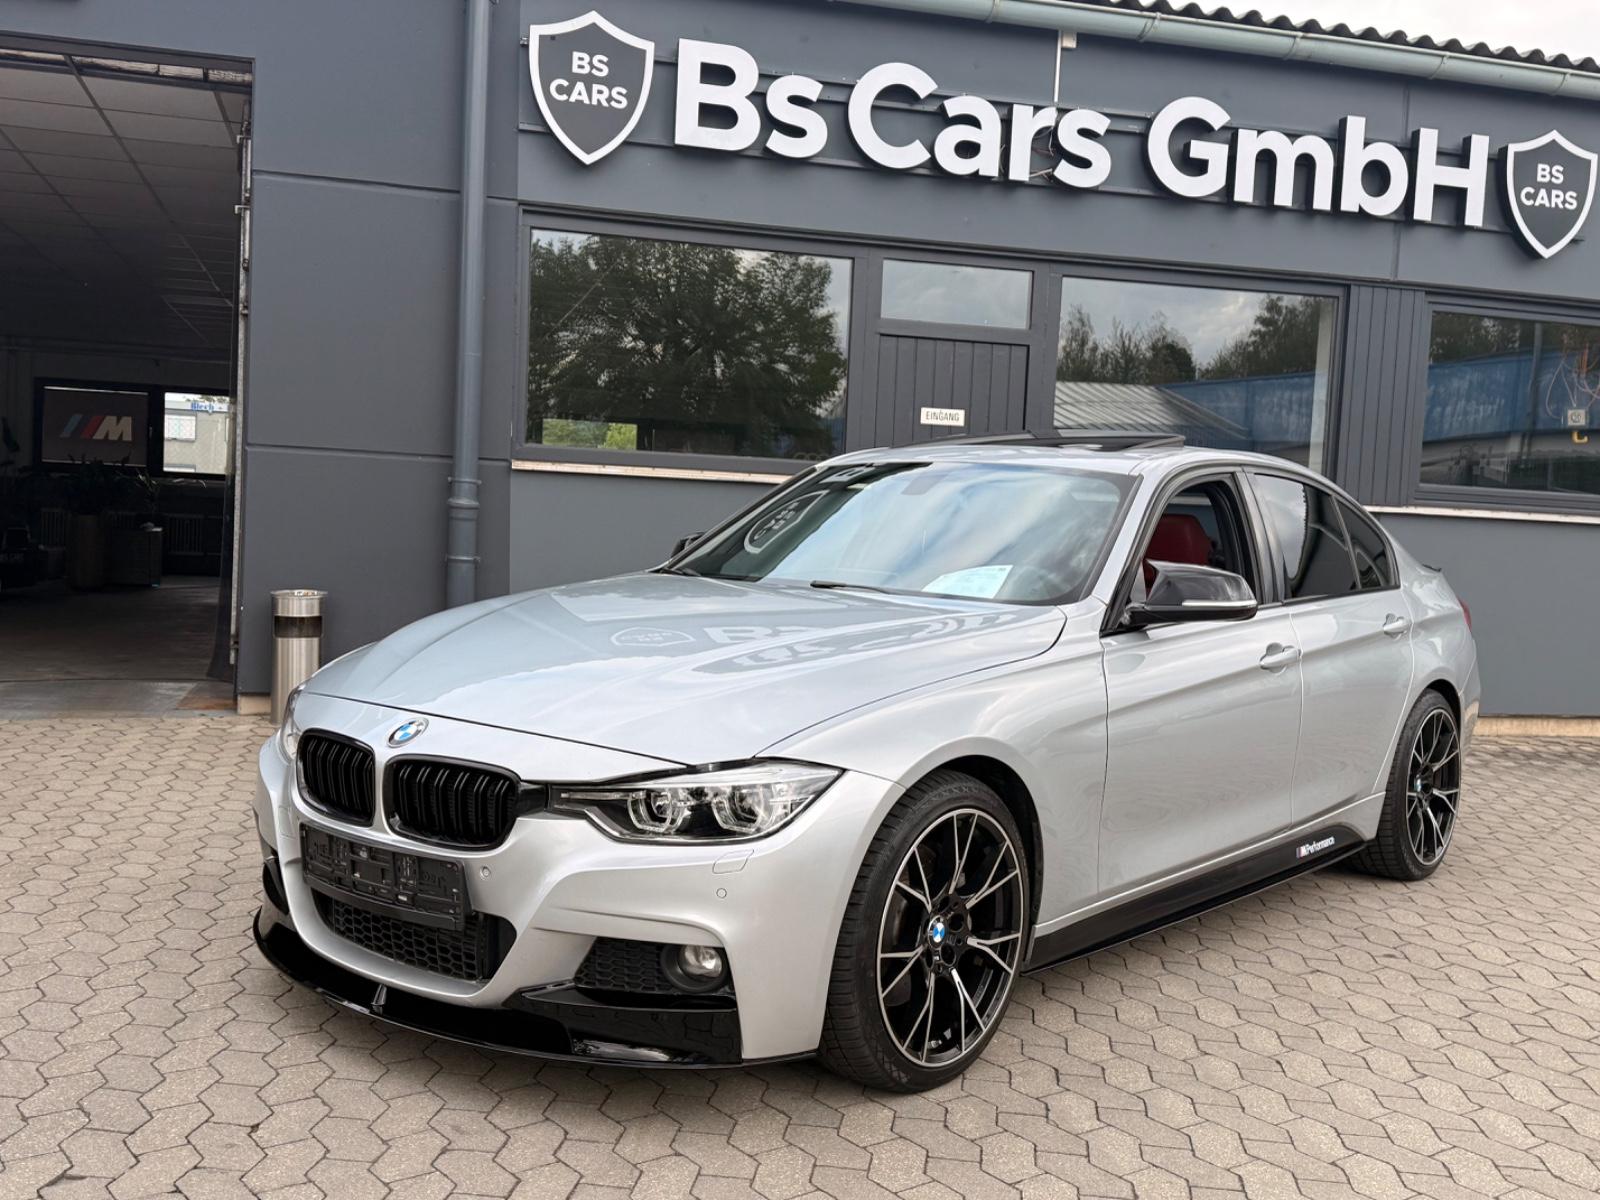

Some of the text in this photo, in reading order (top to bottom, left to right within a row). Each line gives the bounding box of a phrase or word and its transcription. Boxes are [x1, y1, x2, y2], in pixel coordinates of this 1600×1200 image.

[571, 51, 609, 77] BS
[549, 78, 628, 109] CARS
[674, 37, 1490, 228] Bs Cars GmbH
[1536, 163, 1564, 184] BS
[1520, 186, 1578, 210] CARS
[92, 415, 132, 441] M
[925, 411, 960, 422] EINGANG
